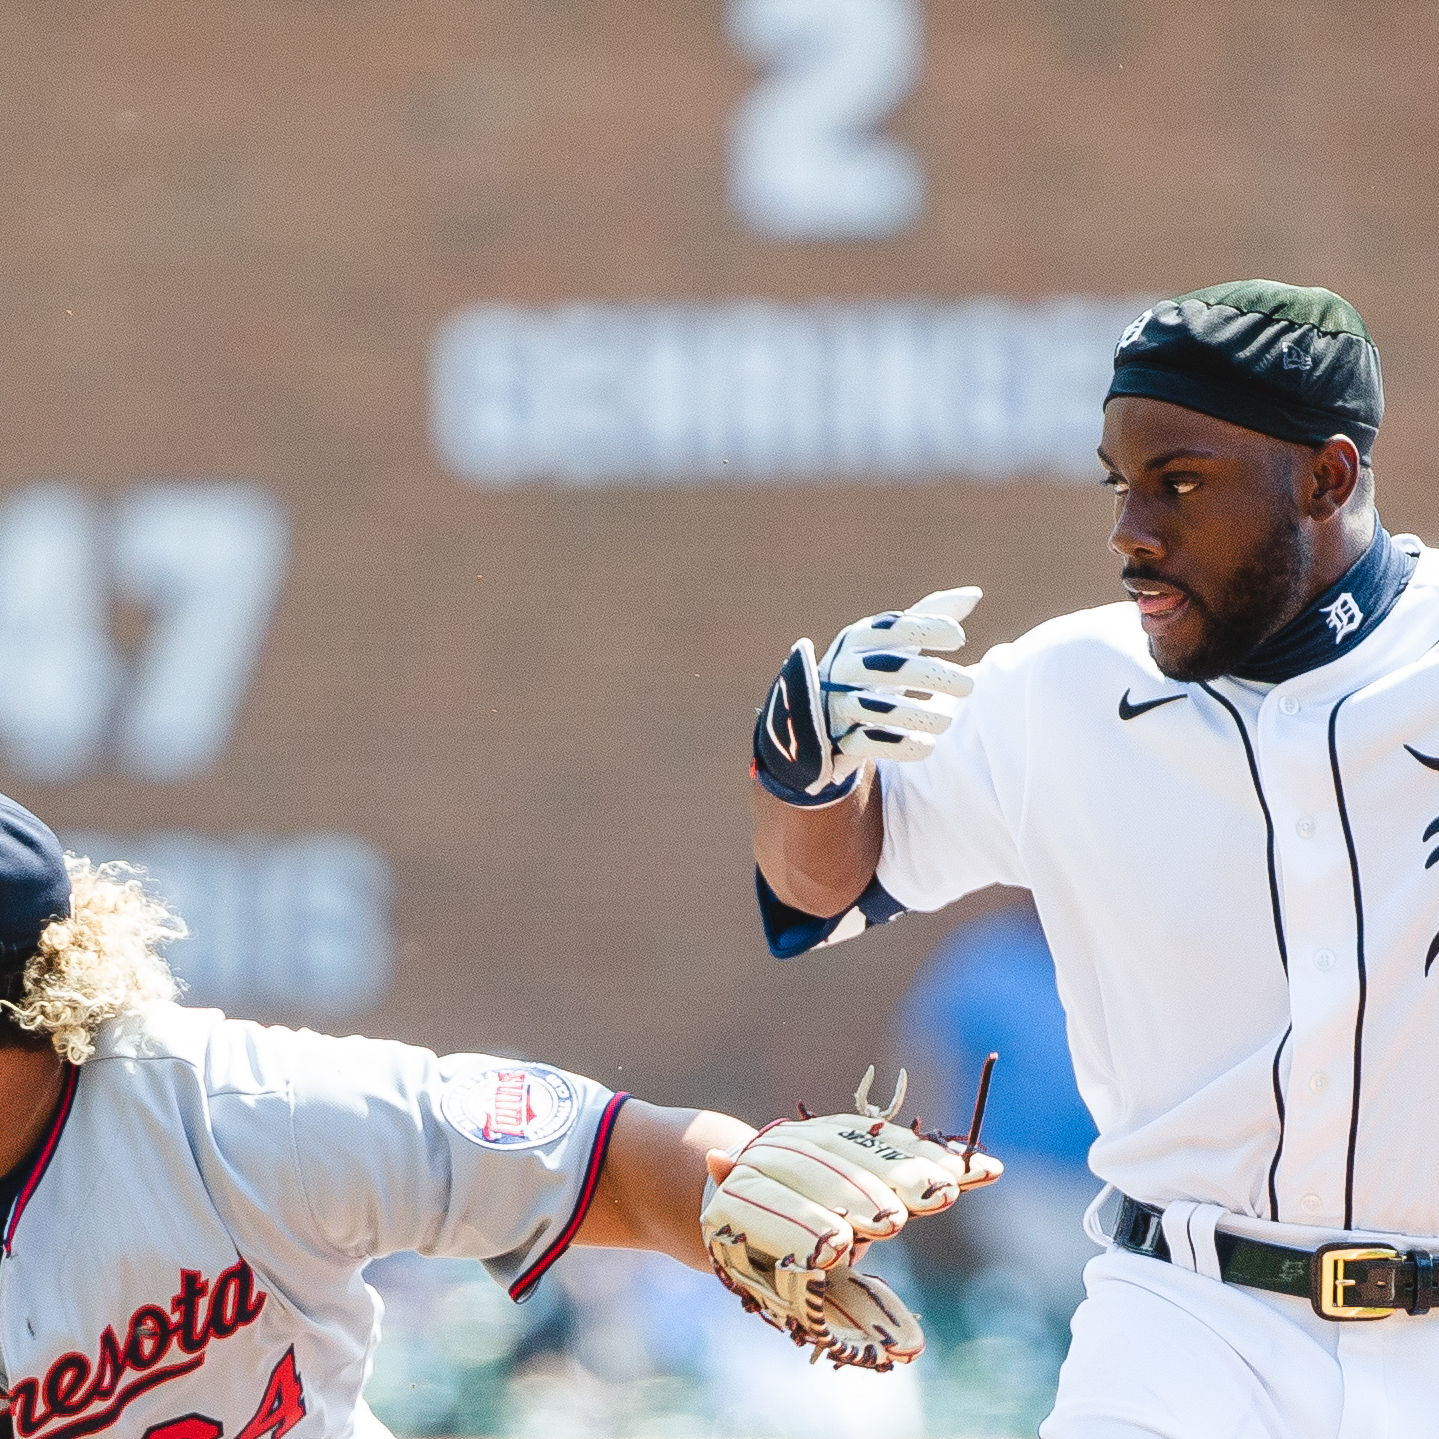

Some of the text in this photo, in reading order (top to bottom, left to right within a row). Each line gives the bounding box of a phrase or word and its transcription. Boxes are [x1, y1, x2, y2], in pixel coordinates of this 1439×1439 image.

[724, 0, 925, 240] 2
[429, 298, 1129, 486] GEHRINGE
[1318, 591, 1364, 645] D
